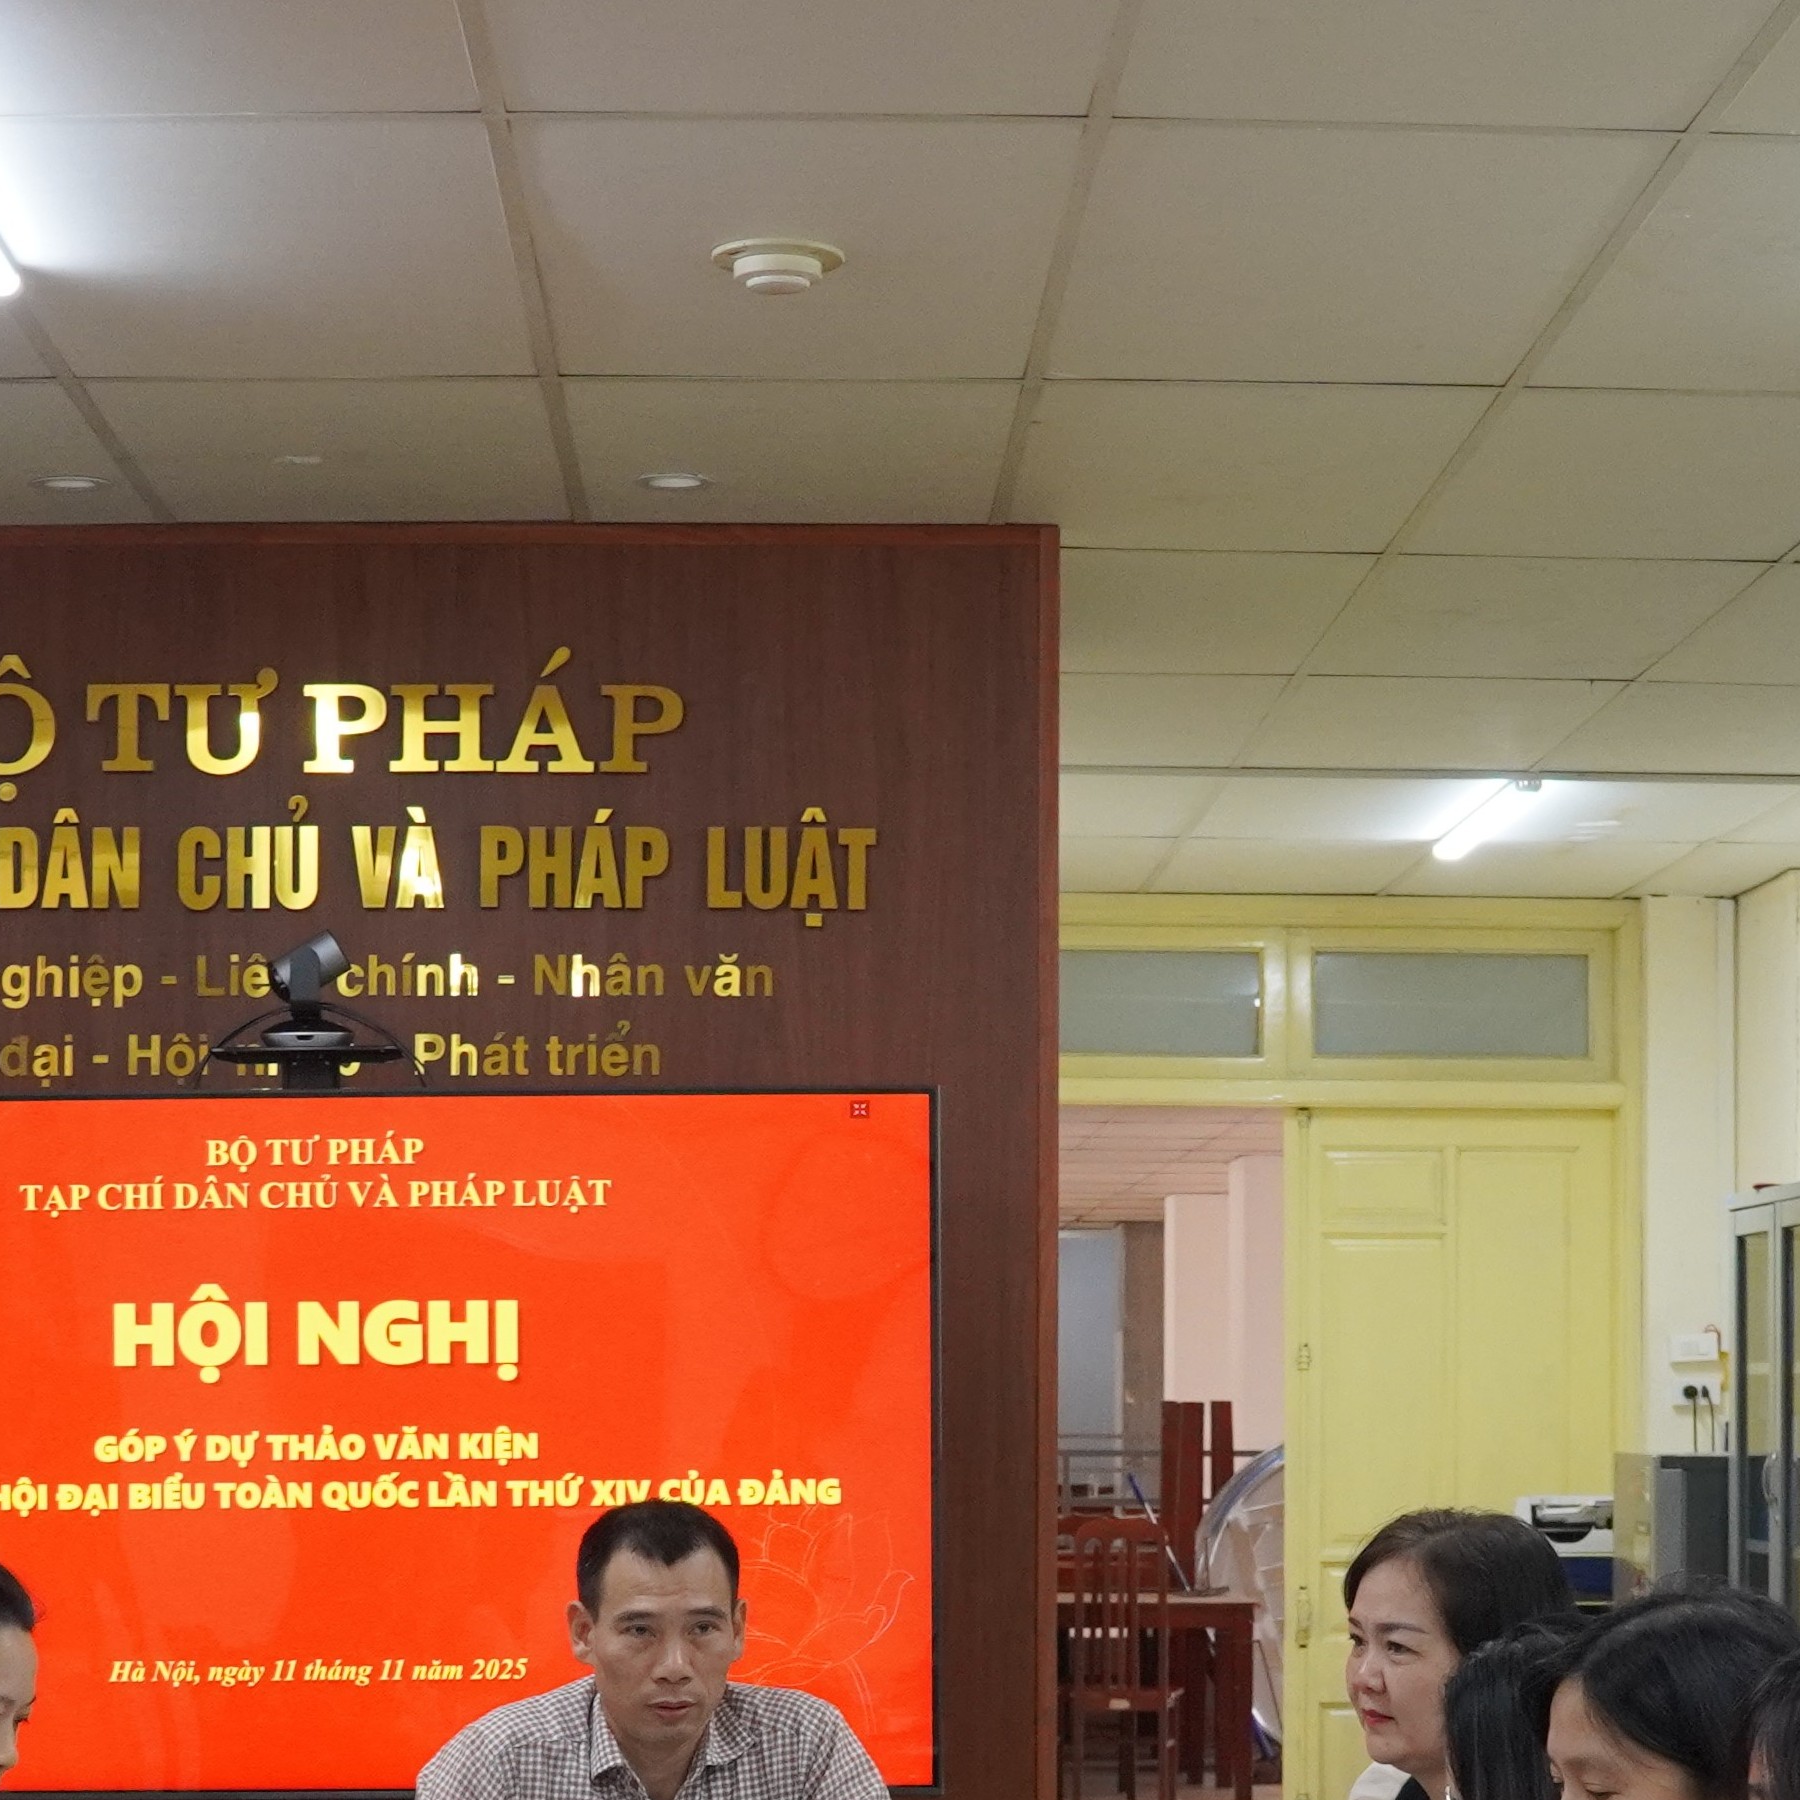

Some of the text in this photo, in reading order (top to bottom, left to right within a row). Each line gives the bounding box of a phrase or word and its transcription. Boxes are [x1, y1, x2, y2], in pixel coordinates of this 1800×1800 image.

[86, 667, 279, 775] TƯ
[302, 646, 686, 774] PHÁP
[177, 795, 319, 911] CHỦ
[351, 806, 446, 909] VÀ
[480, 808, 671, 910] PHÁP
[706, 806, 877, 928] LUẬT
[198, 952, 274, 999] Liê
[334, 950, 480, 998] chính
[534, 952, 665, 998] Nhân
[684, 952, 775, 998] văn
[126, 1032, 211, 1086] Hội
[413, 1031, 529, 1077] Phát
[546, 1019, 661, 1077] triển
[206, 1130, 424, 1172] BỘ TƯ PHÁP
[19, 1172, 612, 1218] TẠP CHÍ DÂN CHỦ VÀ PHÁP LUẬT
[112, 1283, 520, 1384] HỘI NGHỊ
[93, 1424, 540, 1470] GÓP Ý DỰ THẢO VĂN KIỆN
[55, 1483, 119, 1518] ĐẠI
[128, 1467, 206, 1511] BIỂU
[212, 1471, 313, 1511] TOÀN
[321, 1466, 420, 1514] QUỐC
[427, 1467, 498, 1509] LẦN
[505, 1473, 585, 1508] THỨ
[590, 1479, 652, 1507] XIV
[658, 1470, 732, 1506] CỦA
[736, 1469, 842, 1506] ĐẢNG
[108, 1657, 529, 1688] Hà Nội, ngày 11 tháng 11 năm 2025
